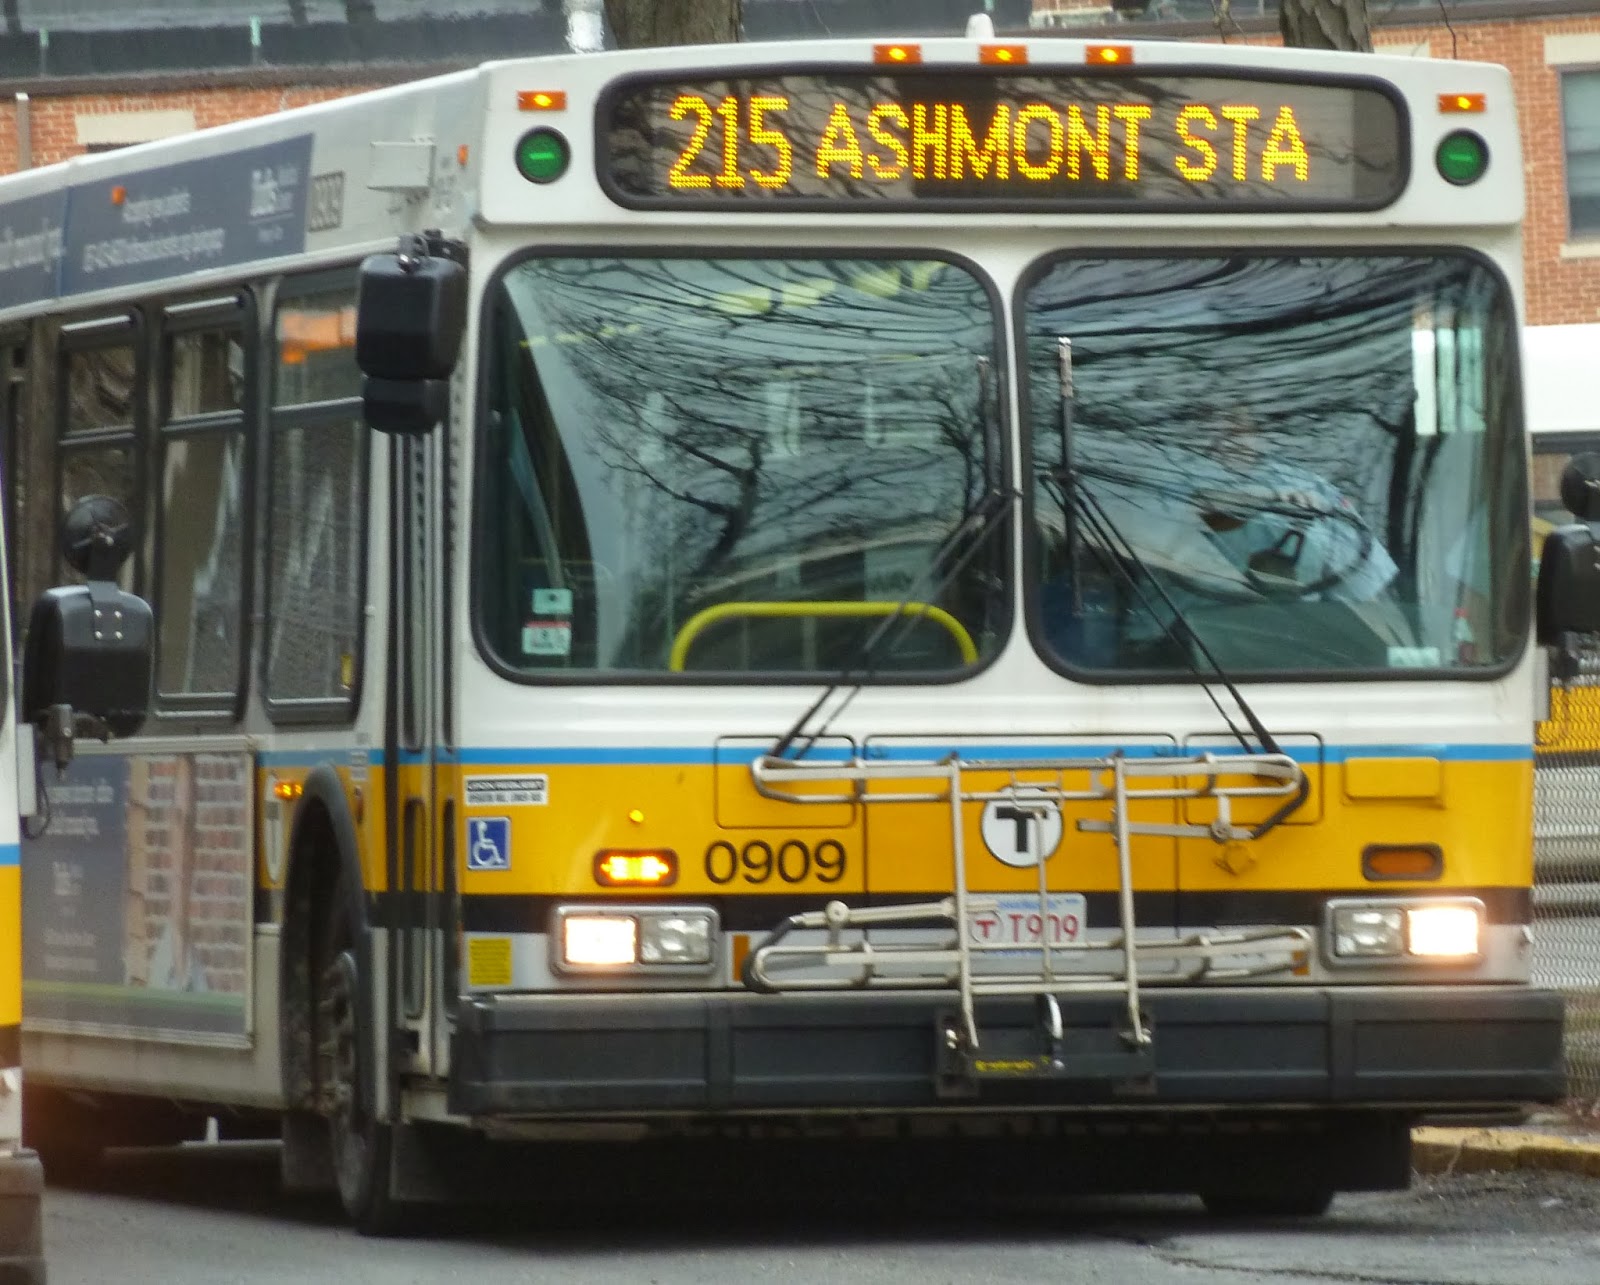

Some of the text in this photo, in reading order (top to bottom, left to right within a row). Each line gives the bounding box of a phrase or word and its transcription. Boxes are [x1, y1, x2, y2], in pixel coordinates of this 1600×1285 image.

[669, 94, 1309, 189] 215 ASHMONT STA
[995, 806, 1048, 853] T
[703, 839, 847, 885] 0909
